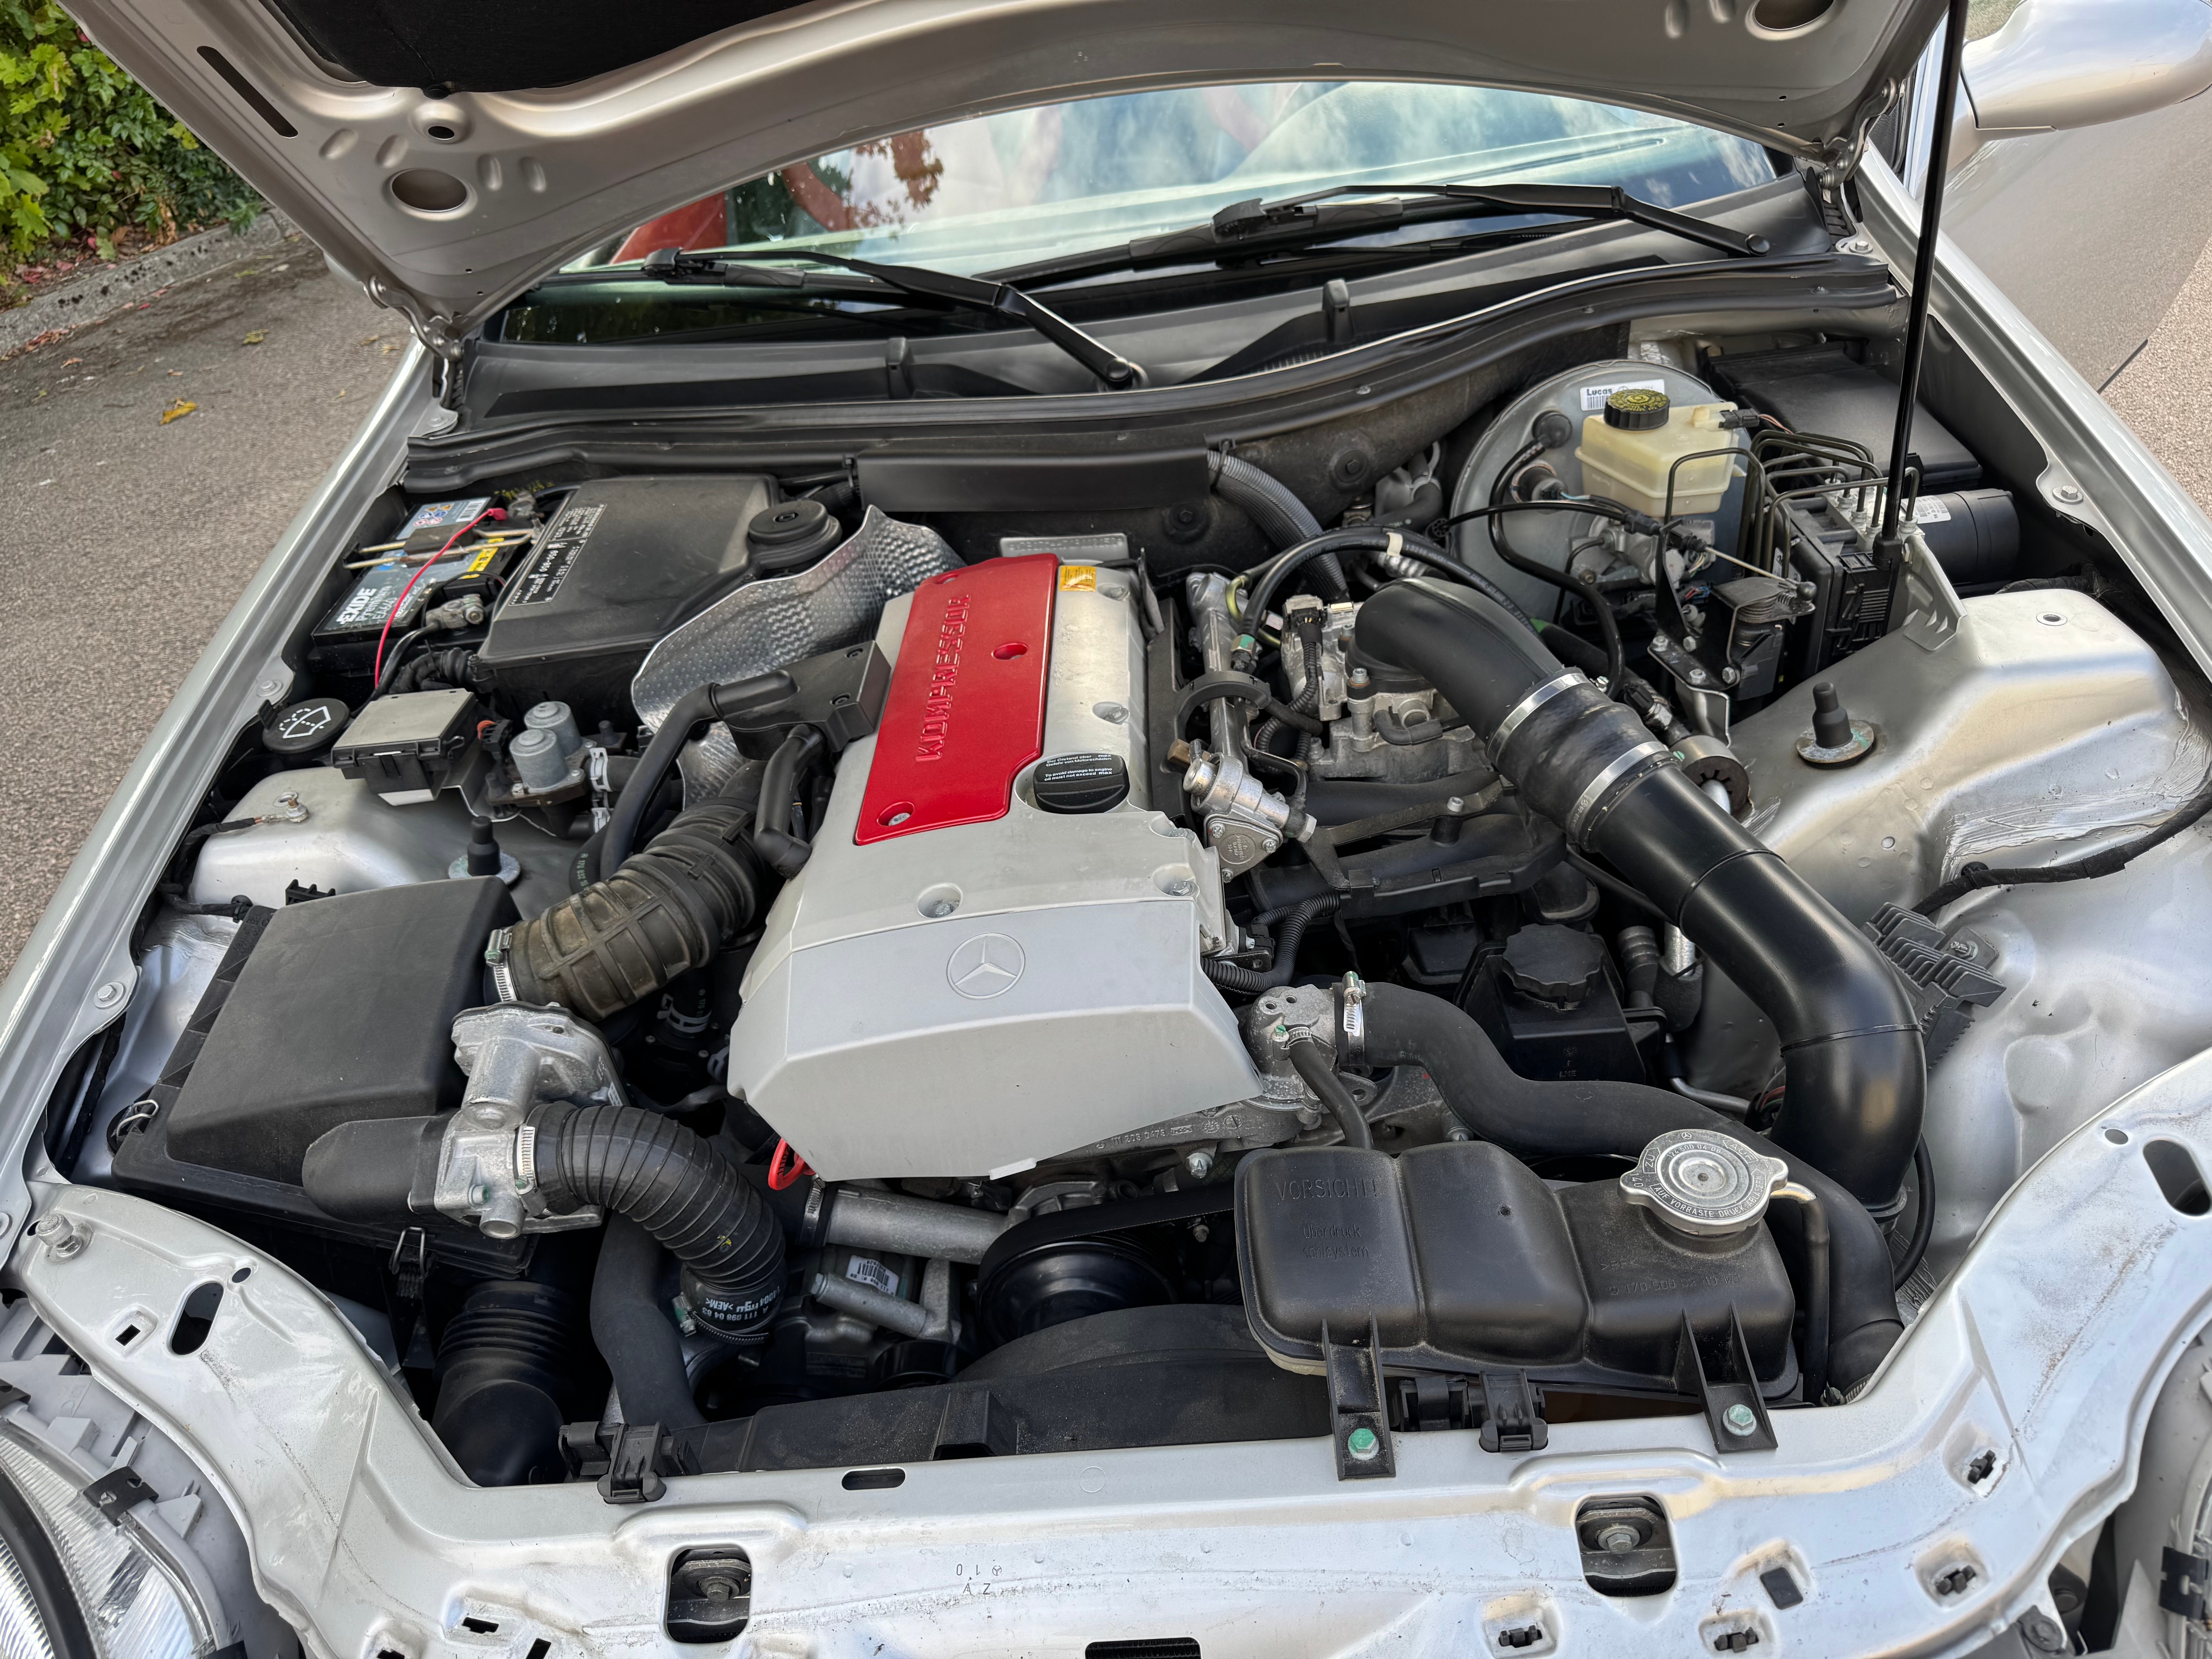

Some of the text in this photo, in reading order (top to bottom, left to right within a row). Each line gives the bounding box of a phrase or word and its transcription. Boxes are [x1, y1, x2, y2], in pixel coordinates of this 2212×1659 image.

[337, 588, 377, 624] EXIDE
[915, 595, 971, 762] KOMPRESSOR
[1666, 1149, 1680, 1159] 124
[1680, 1144, 1695, 1152] 500
[1730, 1143, 1755, 1163] AUF
[1645, 1154, 1655, 1168] ZU
[1629, 1173, 1644, 1188] 140
[1654, 1175, 1765, 1218] AUF VORRASTE DRUCK ABLASSEN
[1303, 1222, 1361, 1238] Überdruck
[714, 1311, 725, 1321] 04
[744, 1311, 757, 1320] 111
[762, 1305, 769, 1314] A
[726, 1313, 742, 1322] 098
